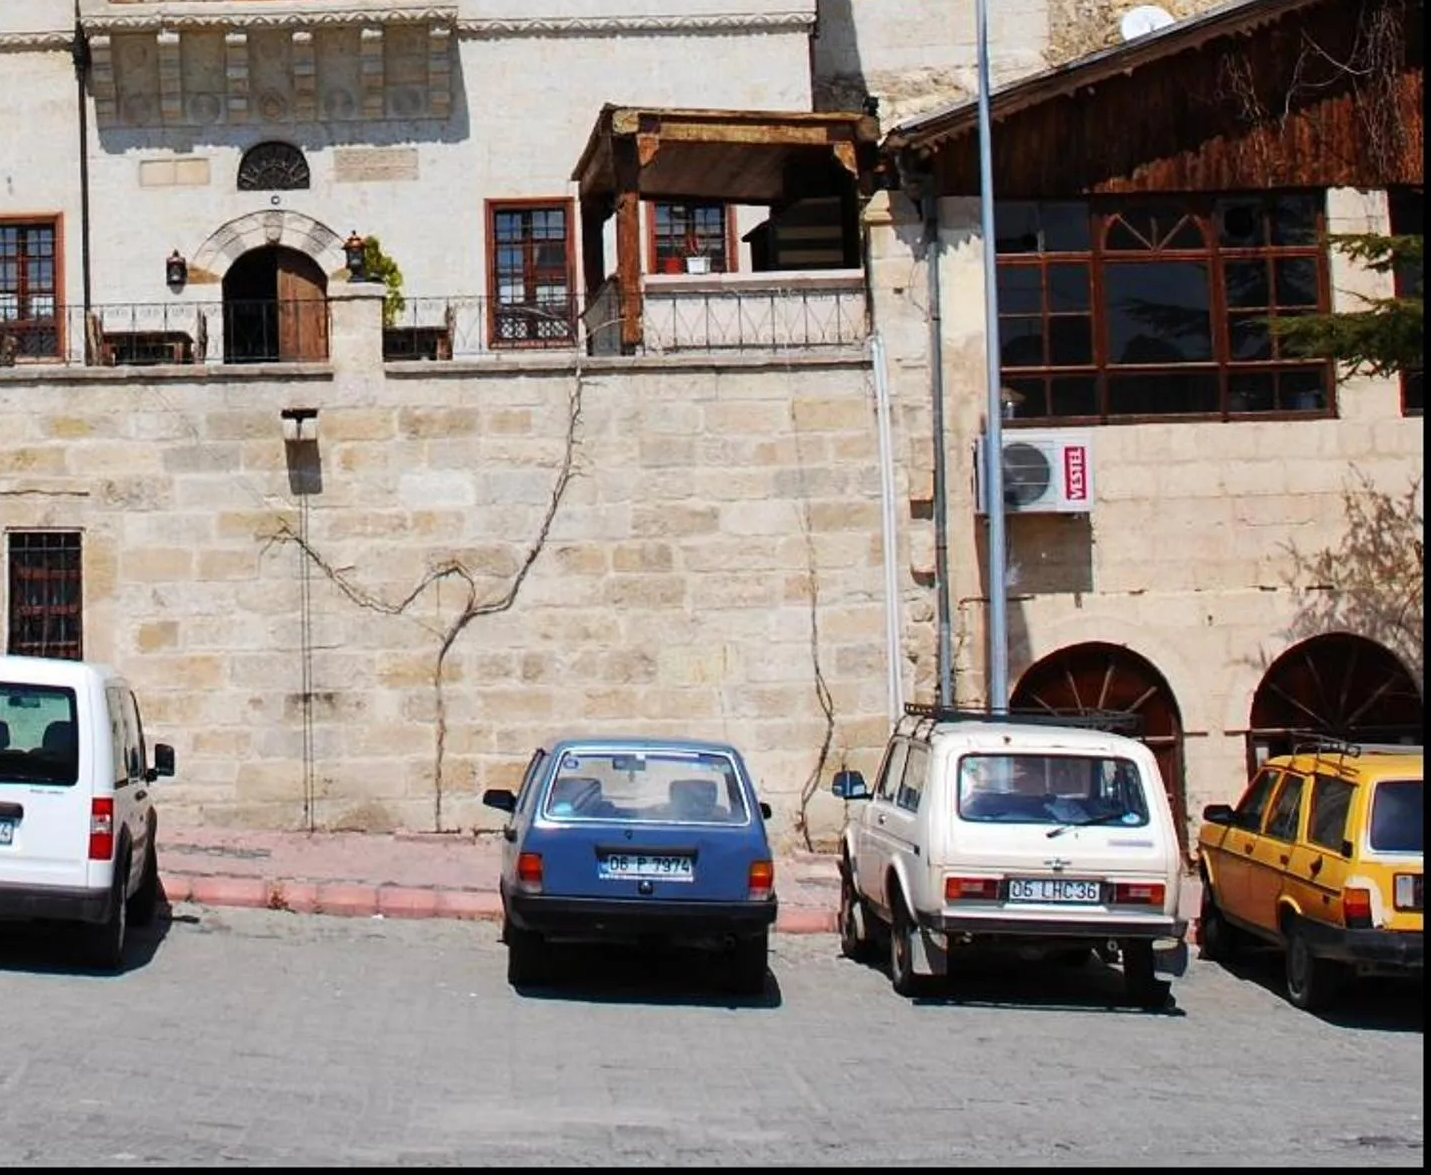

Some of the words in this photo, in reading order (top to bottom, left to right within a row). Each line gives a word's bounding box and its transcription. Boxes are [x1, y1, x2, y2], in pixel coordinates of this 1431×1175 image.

[1069, 447, 1083, 500] VESTEL
[610, 855, 629, 871] 06
[637, 857, 647, 871] P
